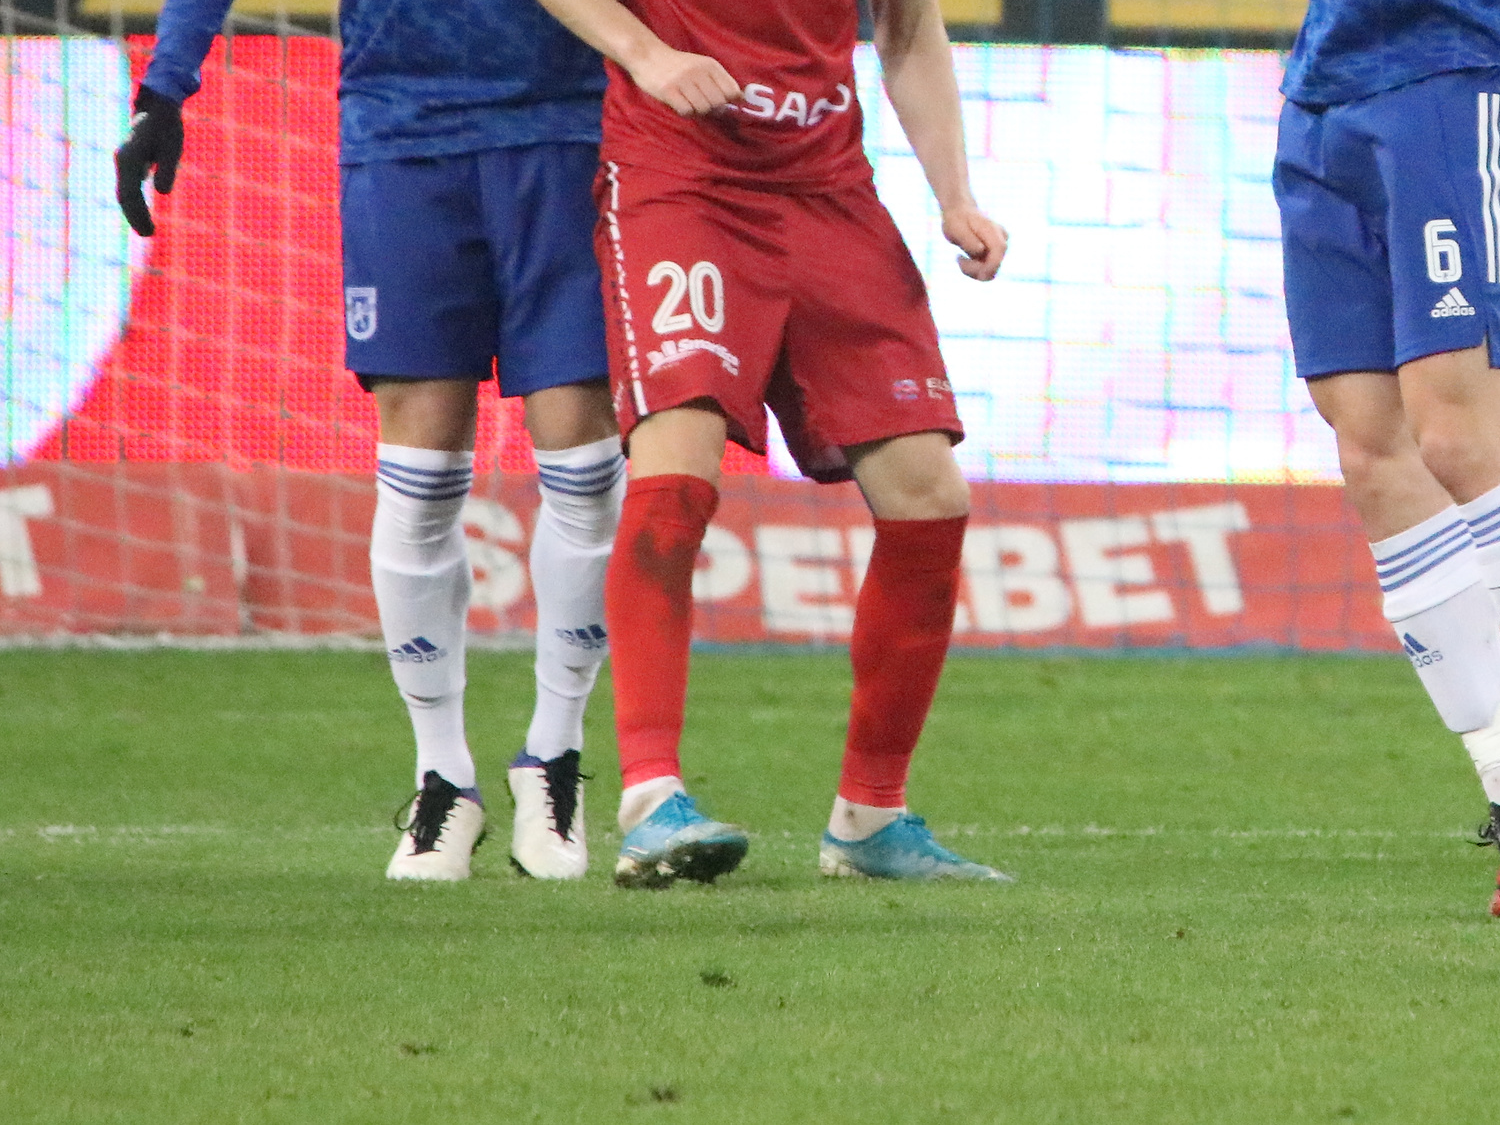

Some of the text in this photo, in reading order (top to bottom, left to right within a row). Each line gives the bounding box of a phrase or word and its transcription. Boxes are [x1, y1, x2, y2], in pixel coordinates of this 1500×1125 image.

[1424, 218, 1463, 284] 6
[647, 260, 725, 334] 20
[1431, 306, 1476, 318] adidas
[463, 497, 1251, 636] SPEBET
